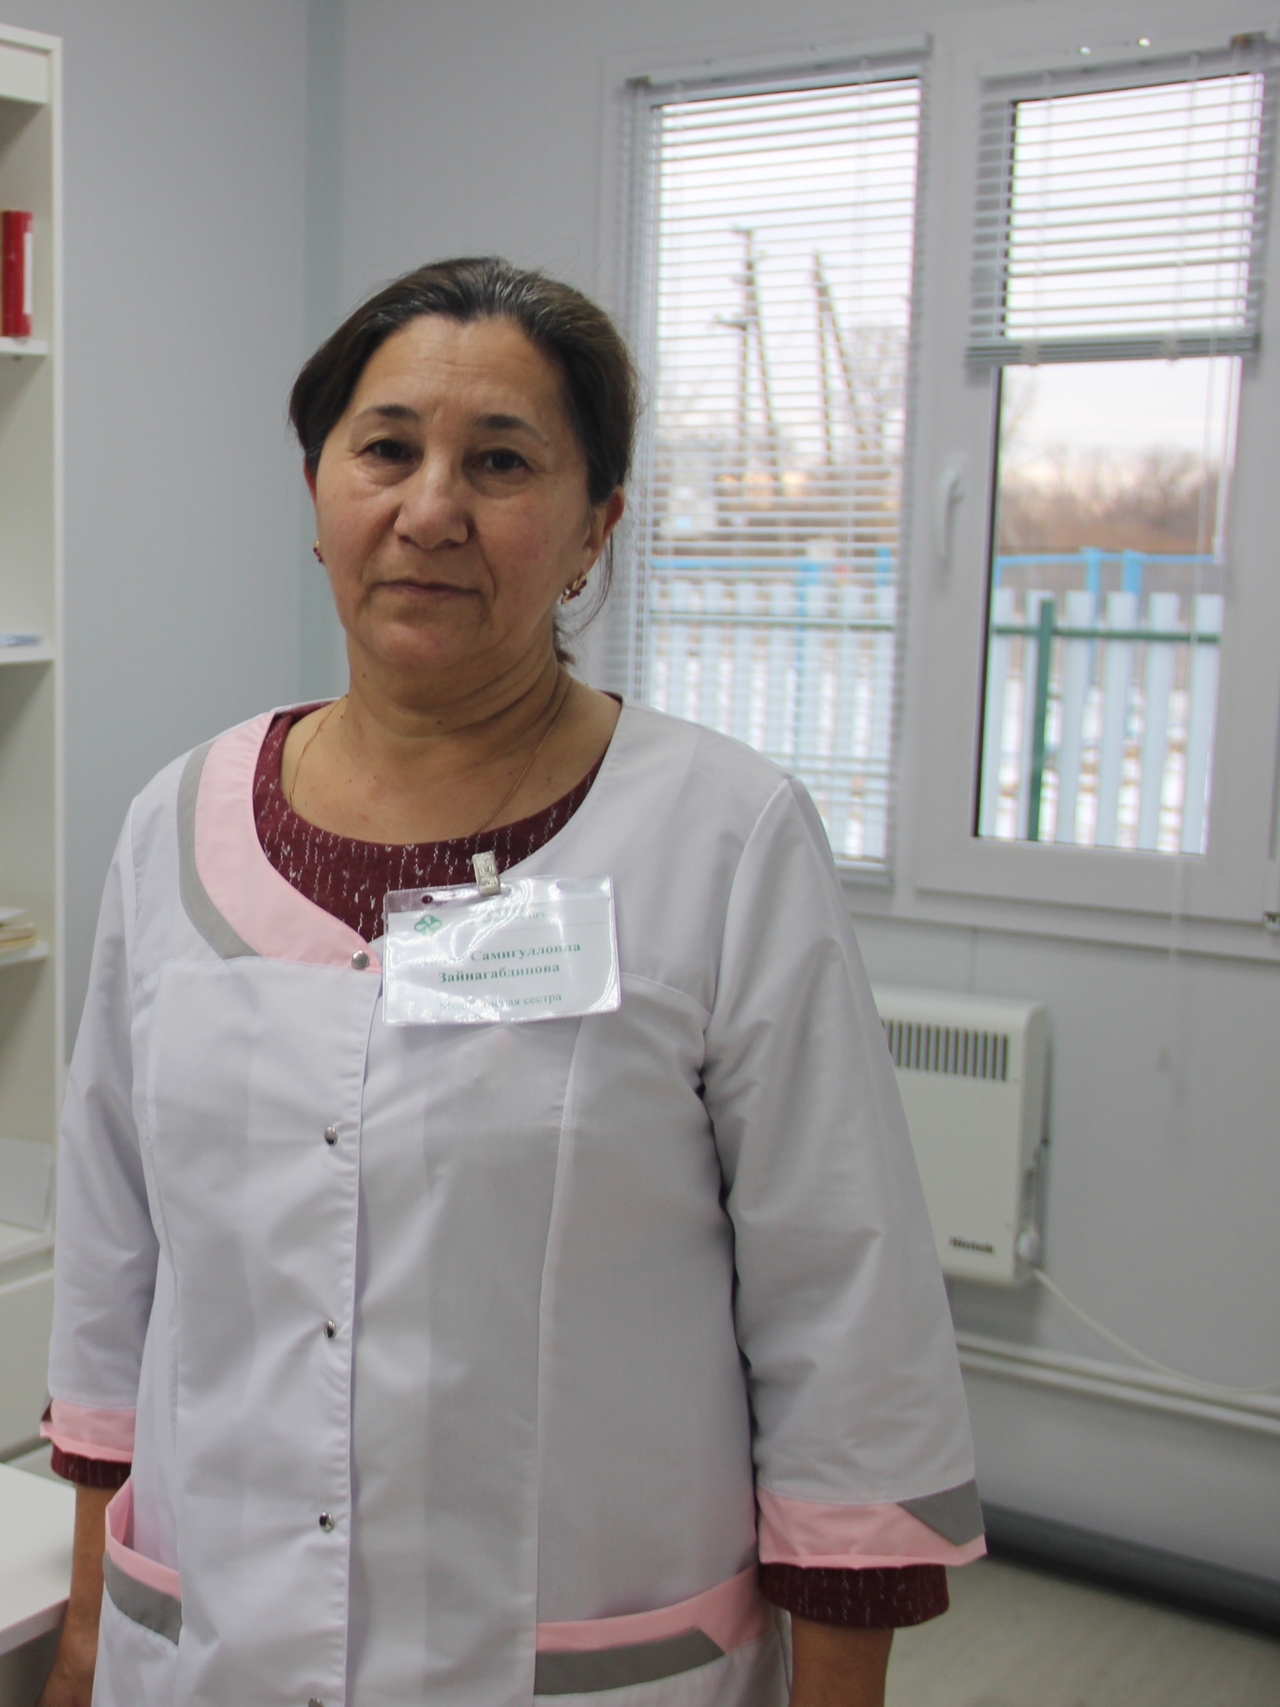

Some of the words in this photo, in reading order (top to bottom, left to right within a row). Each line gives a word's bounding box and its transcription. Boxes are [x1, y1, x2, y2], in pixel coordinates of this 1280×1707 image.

[438, 963, 560, 984] Зайнагабдинова
[439, 999, 520, 1011] Меднсая
[523, 993, 563, 1006] сестра
